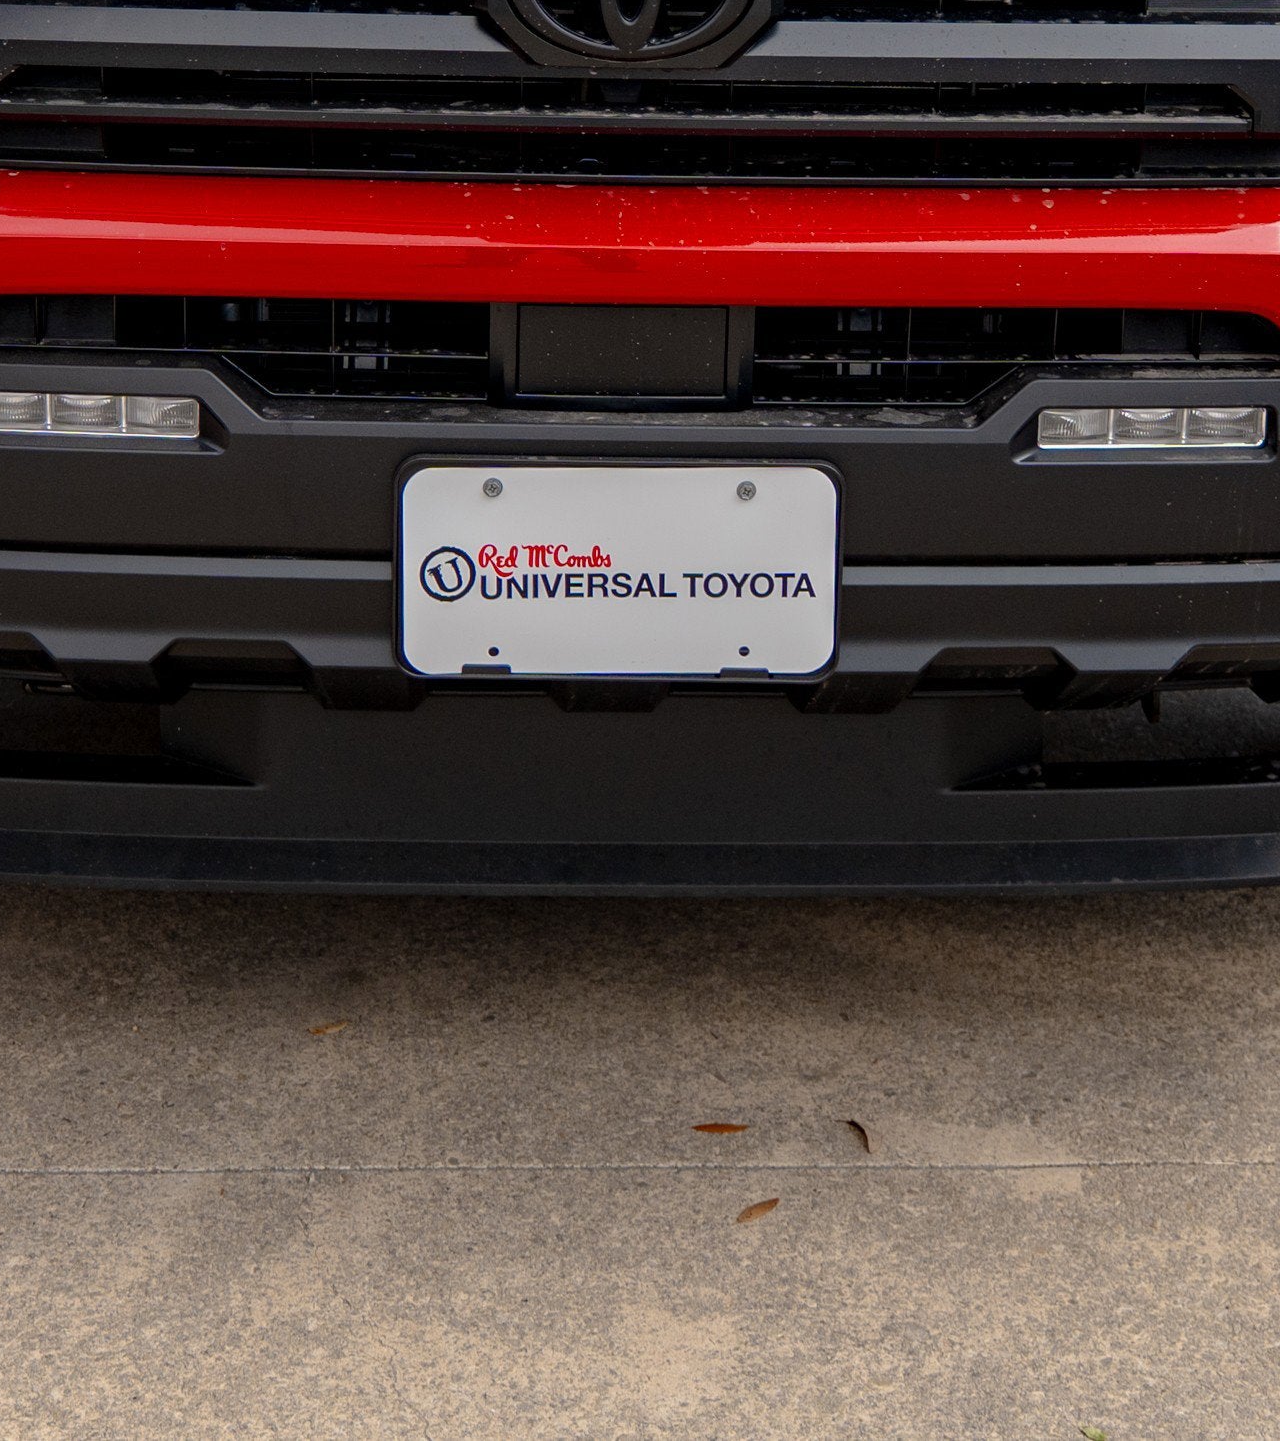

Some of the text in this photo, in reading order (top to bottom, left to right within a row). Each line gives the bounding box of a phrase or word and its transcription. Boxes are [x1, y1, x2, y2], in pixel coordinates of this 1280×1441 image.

[478, 544, 612, 578] Red McCombs
[480, 572, 817, 600] UNIVERSAL TOYOTA
